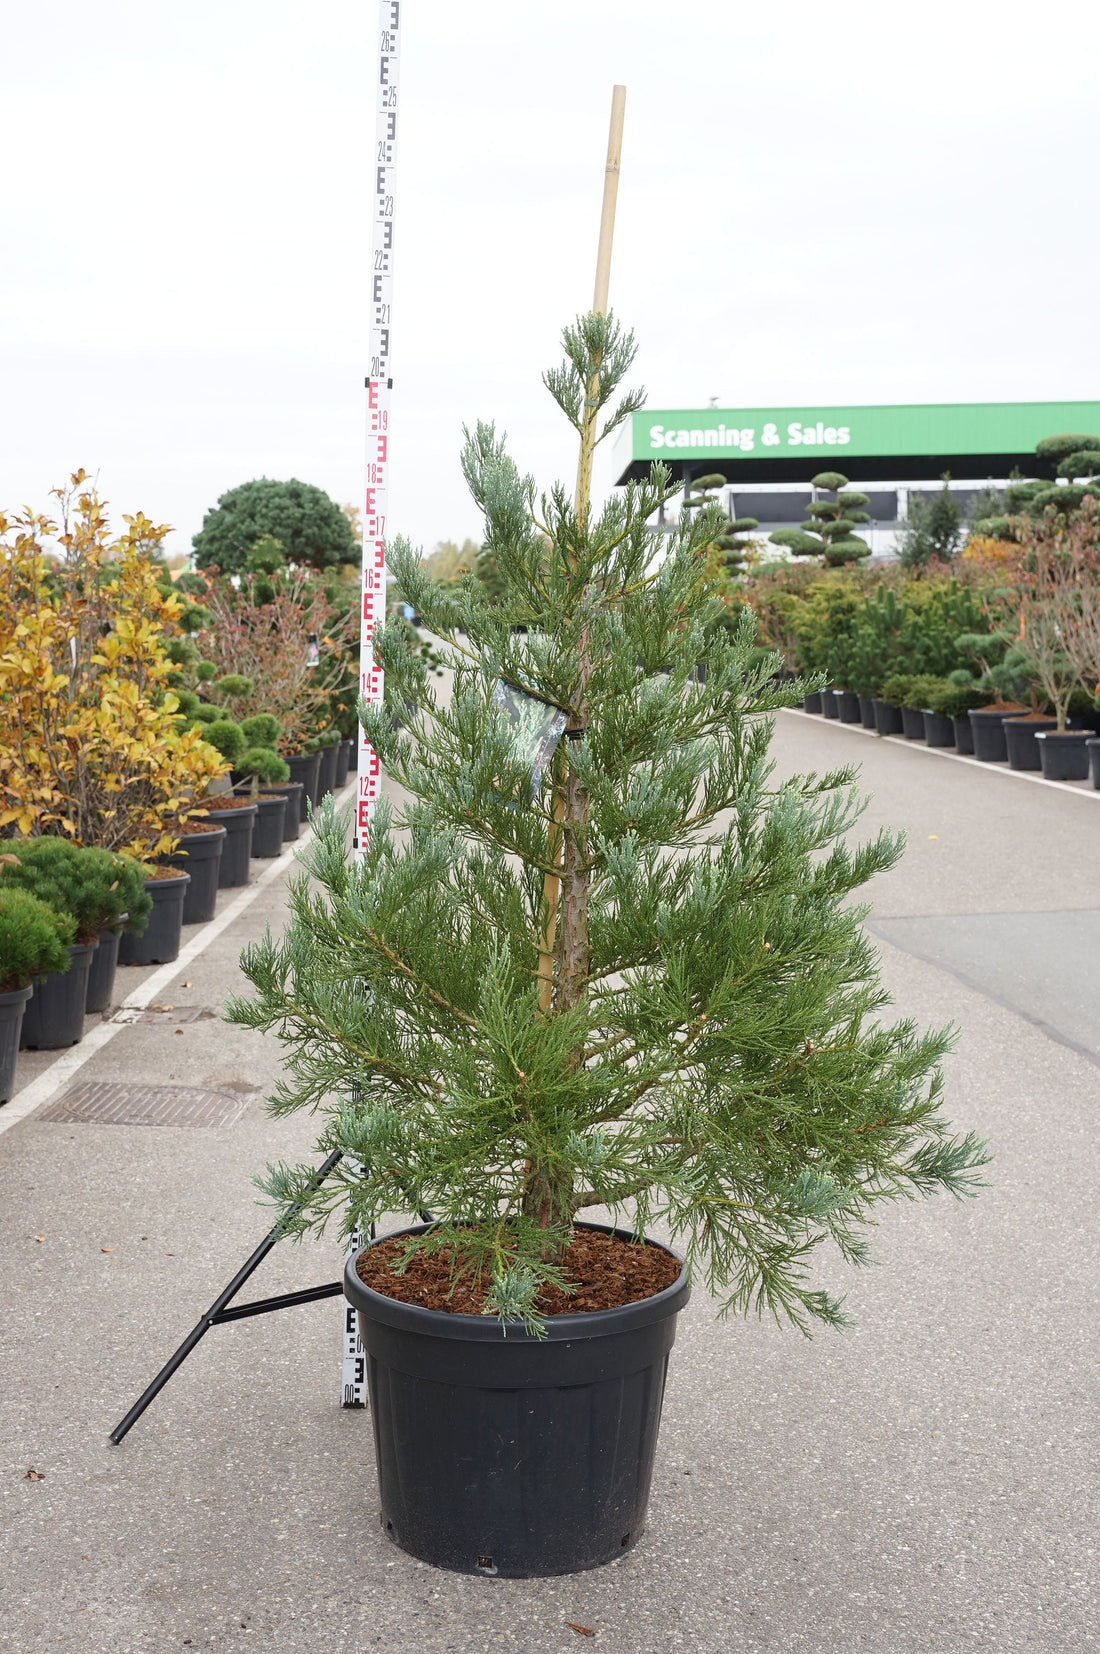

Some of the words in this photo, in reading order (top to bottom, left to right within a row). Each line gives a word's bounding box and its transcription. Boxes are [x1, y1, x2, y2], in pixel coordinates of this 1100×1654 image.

[381, 30, 390, 52] 26
[388, 86, 397, 107] 25
[377, 140, 386, 162] 24
[384, 195, 394, 217] 23
[374, 249, 384, 271] 22
[381, 303, 390, 325] 21
[371, 356, 380, 377] 20
[378, 409, 388, 431] 19
[649, 424, 755, 451] Scanning
[761, 423, 780, 446] &
[787, 422, 851, 446] Sales
[367, 463, 377, 484] 18
[376, 515, 386, 536] 17
[364, 568, 374, 589] 16
[362, 672, 371, 693] 14
[360, 776, 369, 797] 12
